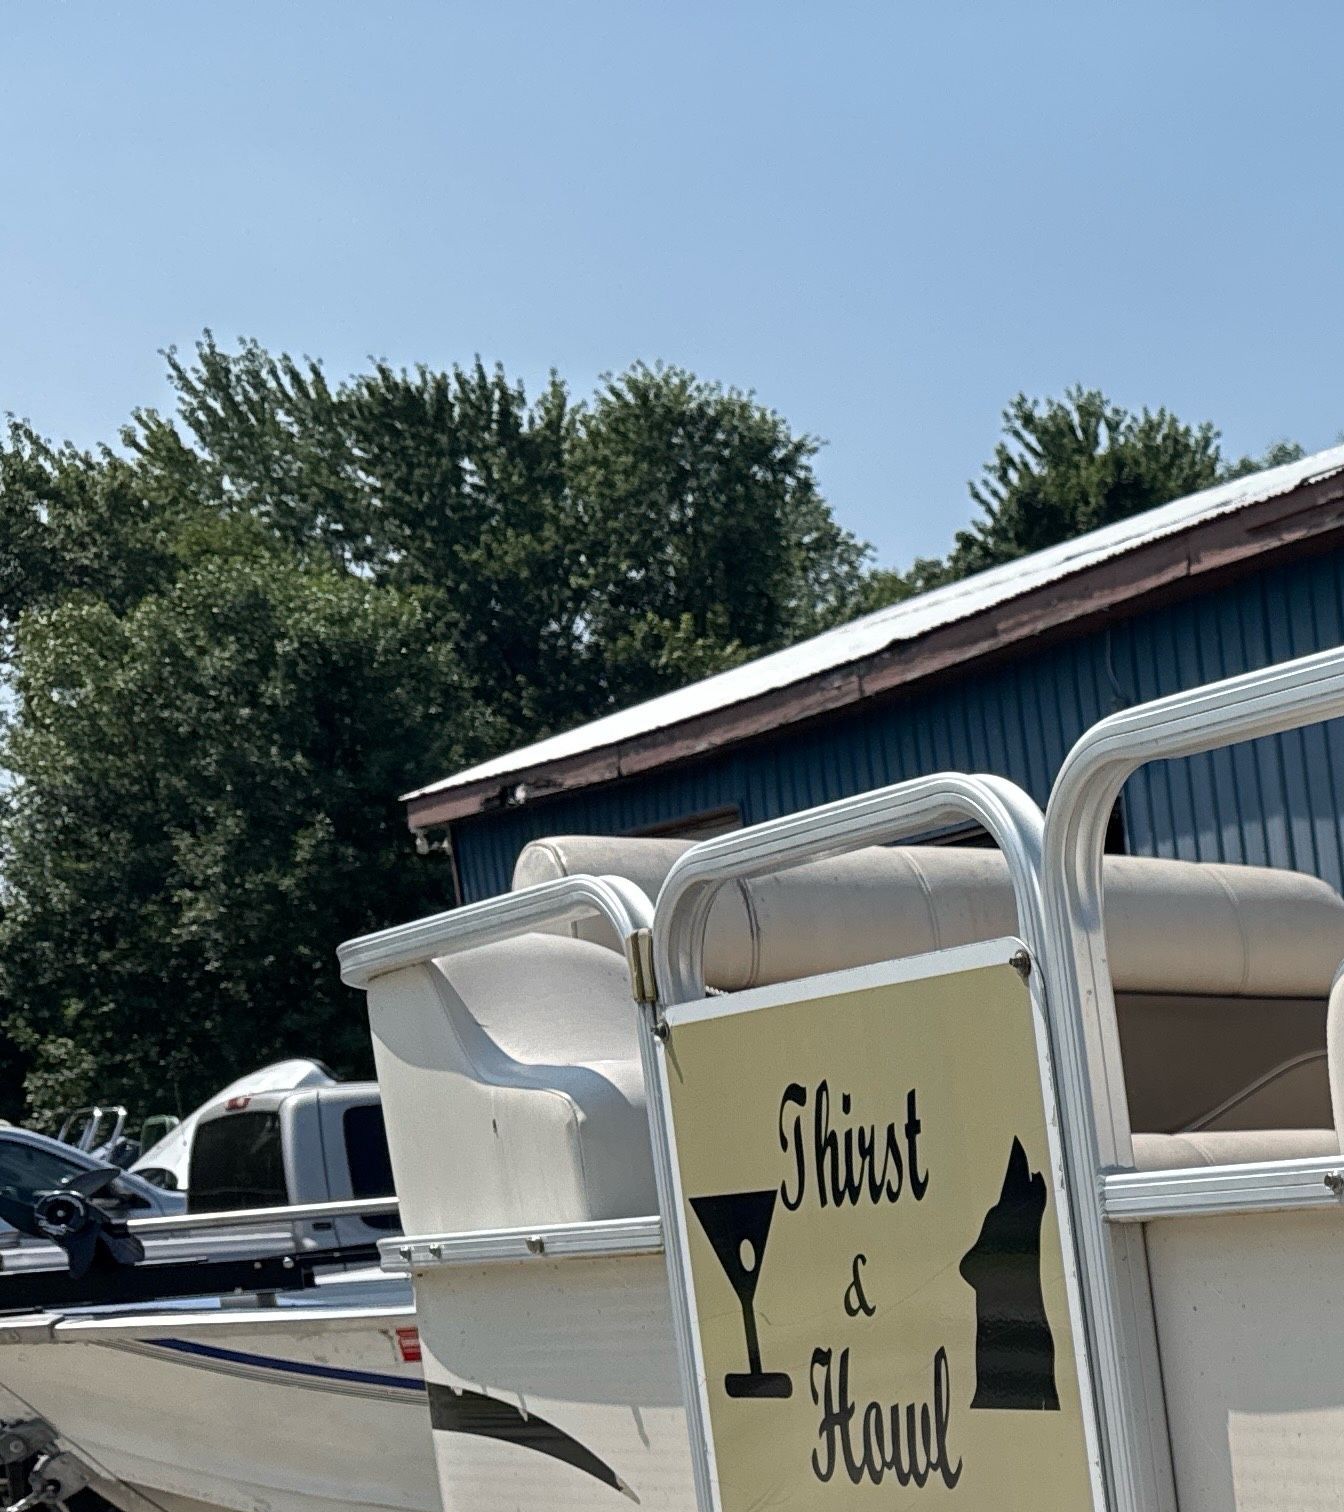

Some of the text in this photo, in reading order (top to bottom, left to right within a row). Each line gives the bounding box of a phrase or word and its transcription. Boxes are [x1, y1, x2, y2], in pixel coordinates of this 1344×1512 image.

[779, 1079, 929, 1212] Thirst
[844, 1253, 876, 1317] &
[810, 1345, 963, 1490] Howl
